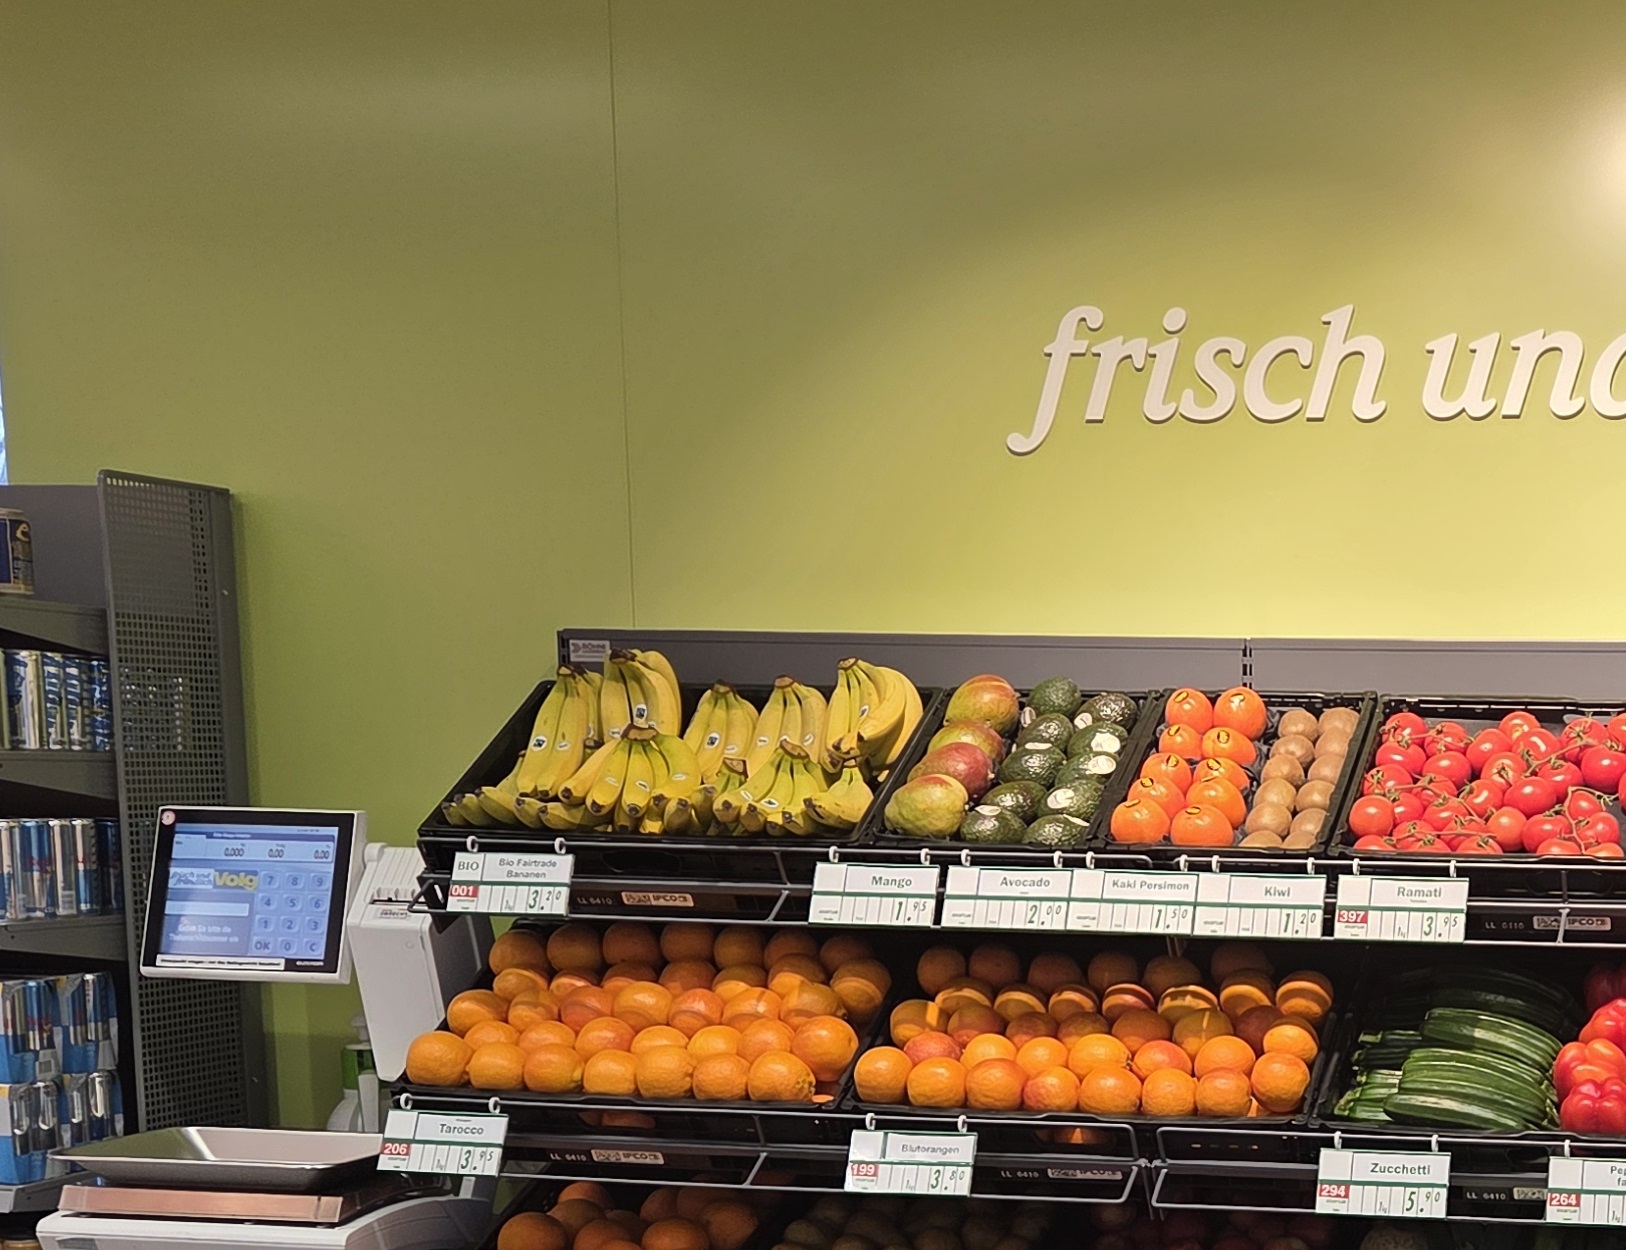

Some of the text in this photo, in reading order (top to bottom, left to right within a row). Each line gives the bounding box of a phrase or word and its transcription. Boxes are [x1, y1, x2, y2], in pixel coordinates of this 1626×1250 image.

[1006, 305, 1386, 455] frisch
[458, 861, 479, 871] BIO
[499, 858, 556, 868] Bio Fairtrade
[507, 870, 546, 879] Bananen
[214, 870, 259, 892] Volg
[872, 876, 912, 888] Mango
[1000, 877, 1050, 888] Avocado
[1113, 880, 1189, 891] Kaki Persimon
[452, 886, 473, 896] 001
[1265, 887, 1290, 897] Kiwi
[1398, 886, 1442, 898] Ramati
[1339, 911, 1365, 922] 397
[254, 941, 270, 950] OK
[439, 1124, 484, 1135] Tarocco
[384, 1143, 407, 1154] 206
[902, 1144, 959, 1155] Blutorangen
[852, 1164, 875, 1175] 199
[1370, 1163, 1430, 1175] Zucchetti
[1321, 1185, 1346, 1196] 294
[1406, 1191, 1440, 1212] 5.90
[1551, 1194, 1577, 1206] 264
